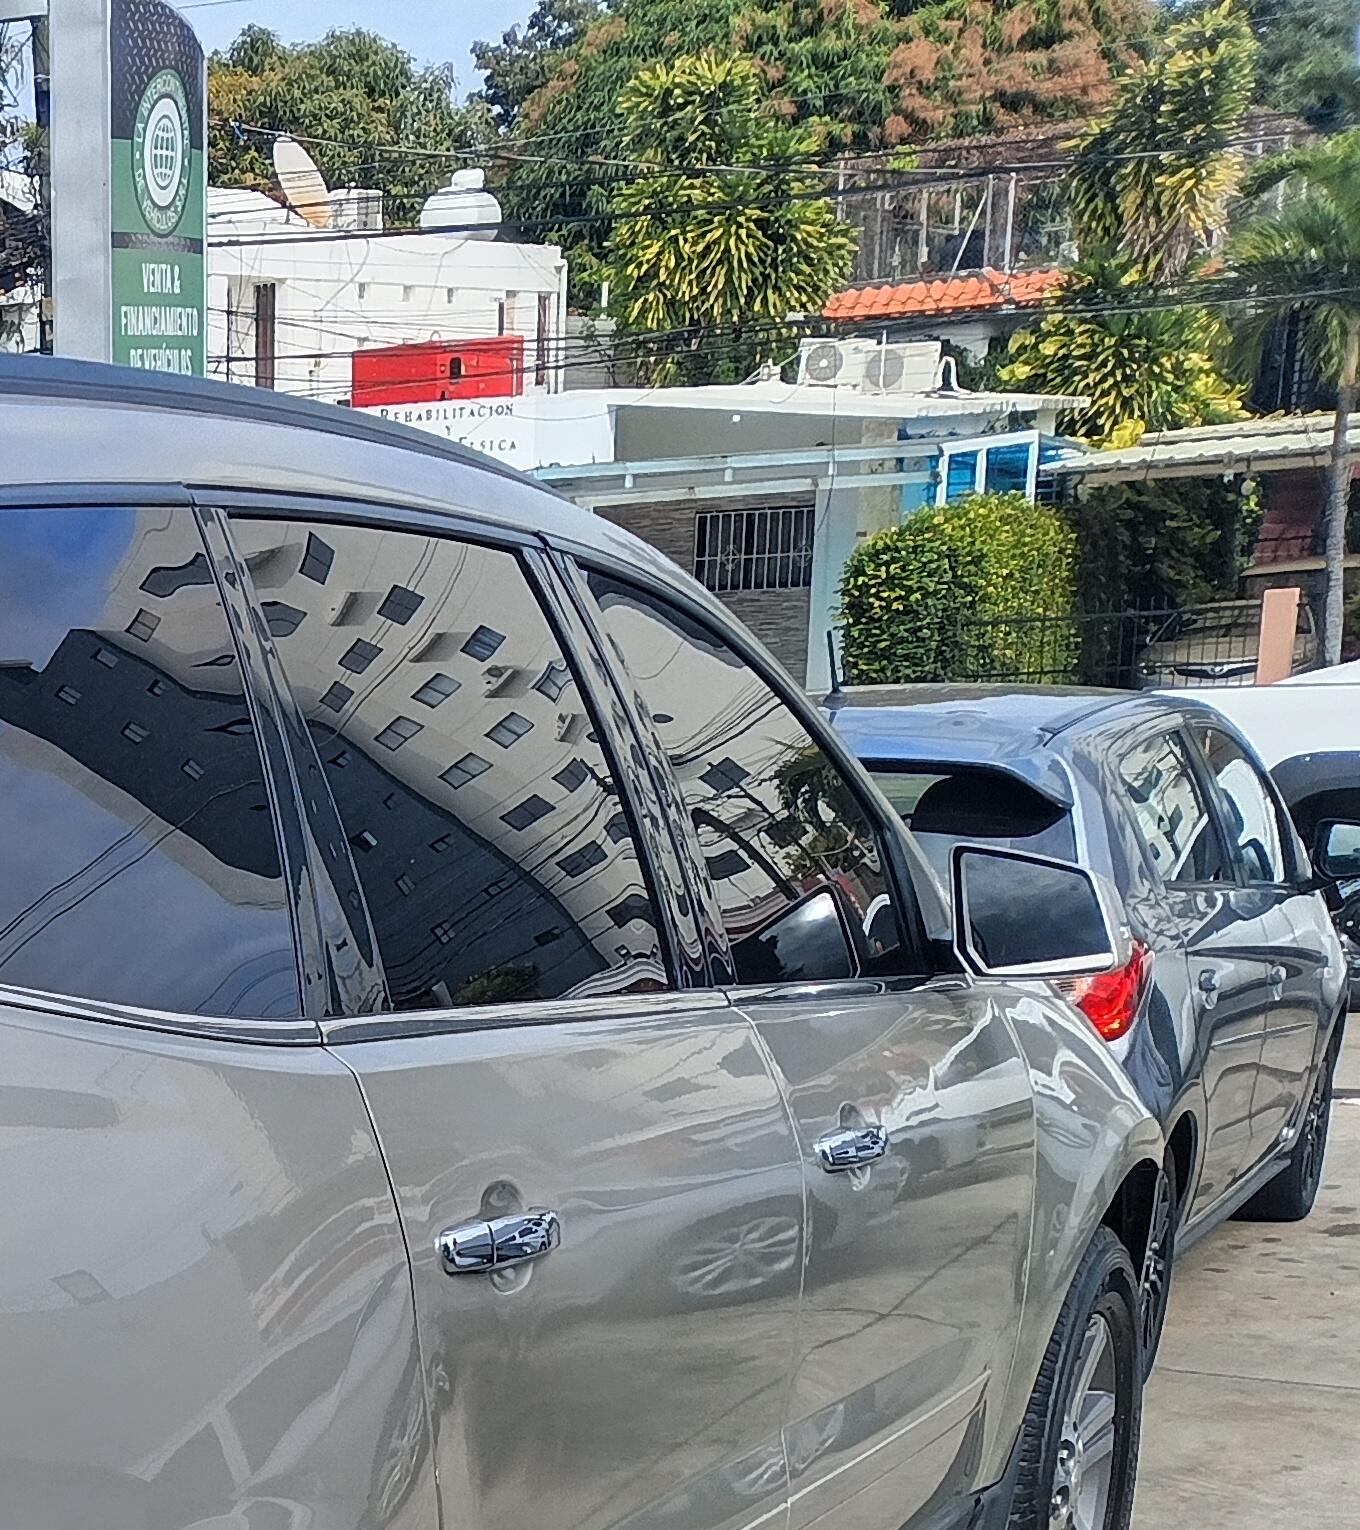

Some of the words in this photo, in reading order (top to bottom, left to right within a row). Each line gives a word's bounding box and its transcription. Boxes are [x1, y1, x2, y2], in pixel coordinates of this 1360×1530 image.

[142, 263, 172, 293] VENTA
[173, 265, 180, 293] &
[120, 305, 198, 336] FINANCIAMIENTO
[129, 348, 142, 368] DE
[380, 402, 514, 422] REHABILITACION
